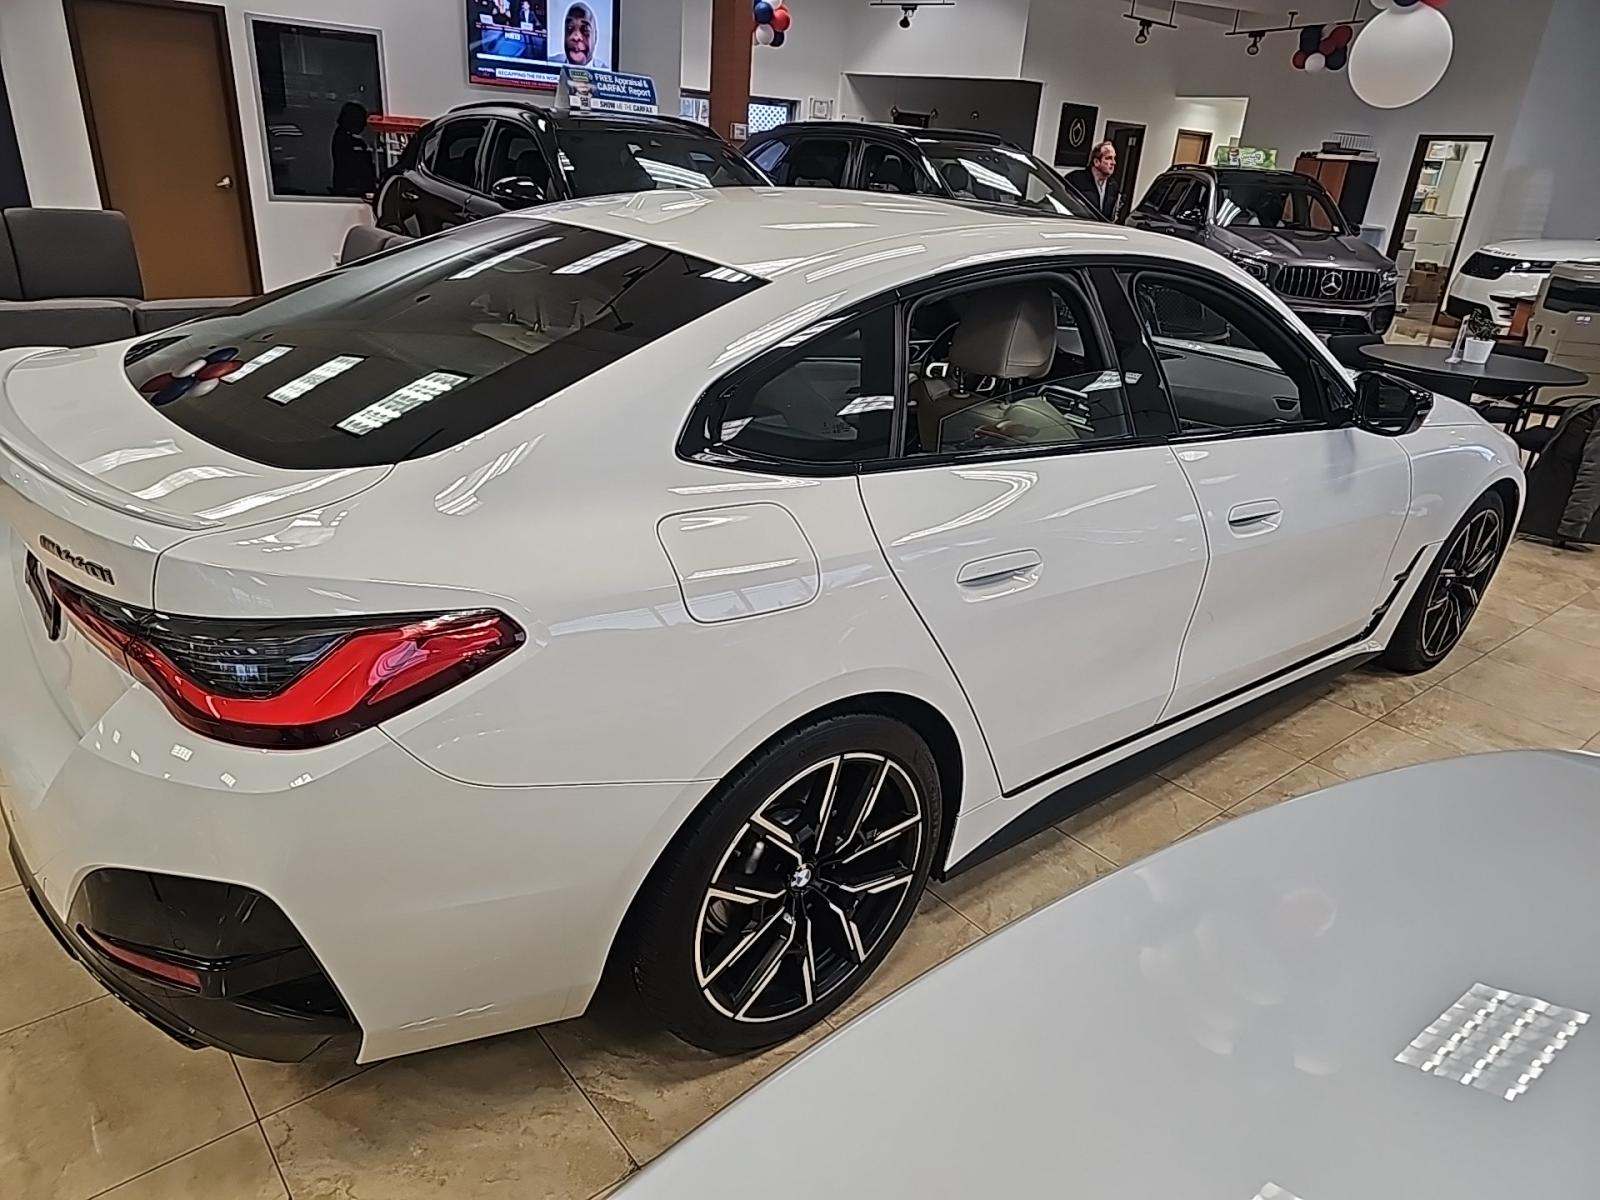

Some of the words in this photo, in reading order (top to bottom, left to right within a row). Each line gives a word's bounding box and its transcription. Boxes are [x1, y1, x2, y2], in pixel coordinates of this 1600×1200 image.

[594, 73, 613, 83] FREE
[614, 76, 643, 88] Appraisal
[597, 82, 627, 94] CARFAX
[628, 86, 651, 97] Report
[600, 100, 615, 109] SHOW
[633, 104, 653, 113] CARFAX
